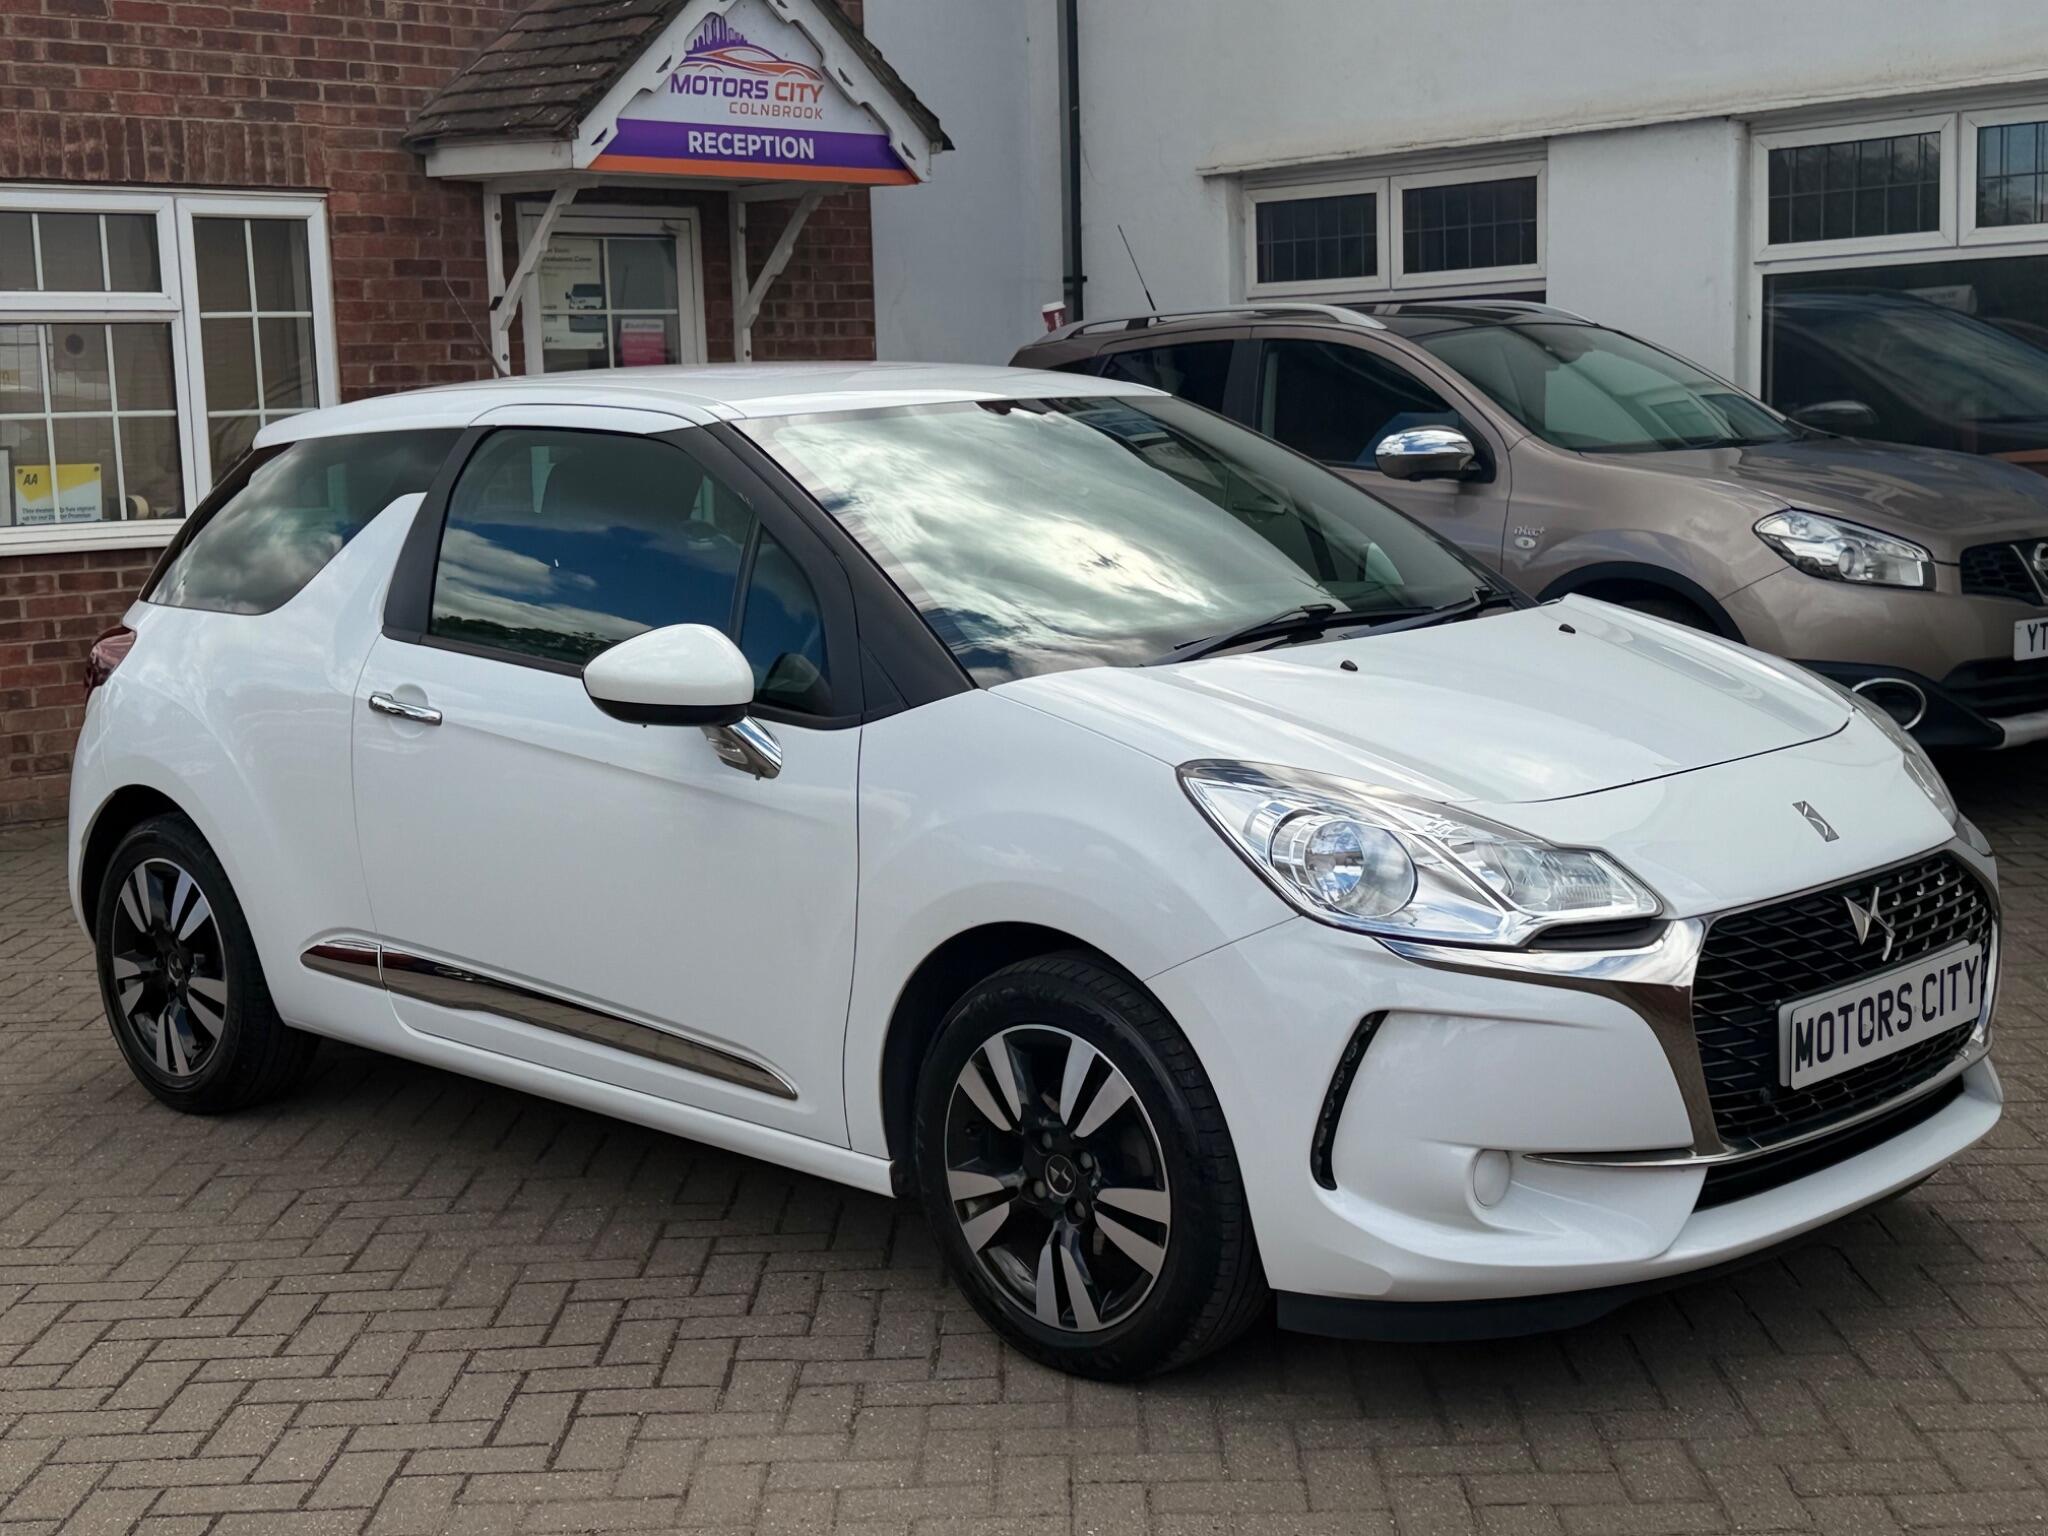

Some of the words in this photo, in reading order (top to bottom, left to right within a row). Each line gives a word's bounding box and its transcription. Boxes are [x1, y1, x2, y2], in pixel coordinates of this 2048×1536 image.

[670, 73, 769, 100] MOTORS
[774, 81, 825, 104] CITY
[729, 102, 824, 121] COLNBROOK
[688, 130, 815, 160] RECEPTION
[23, 473, 38, 486] AA
[1794, 981, 1913, 1074] MOTORS
[1921, 955, 1980, 1023] CITY
